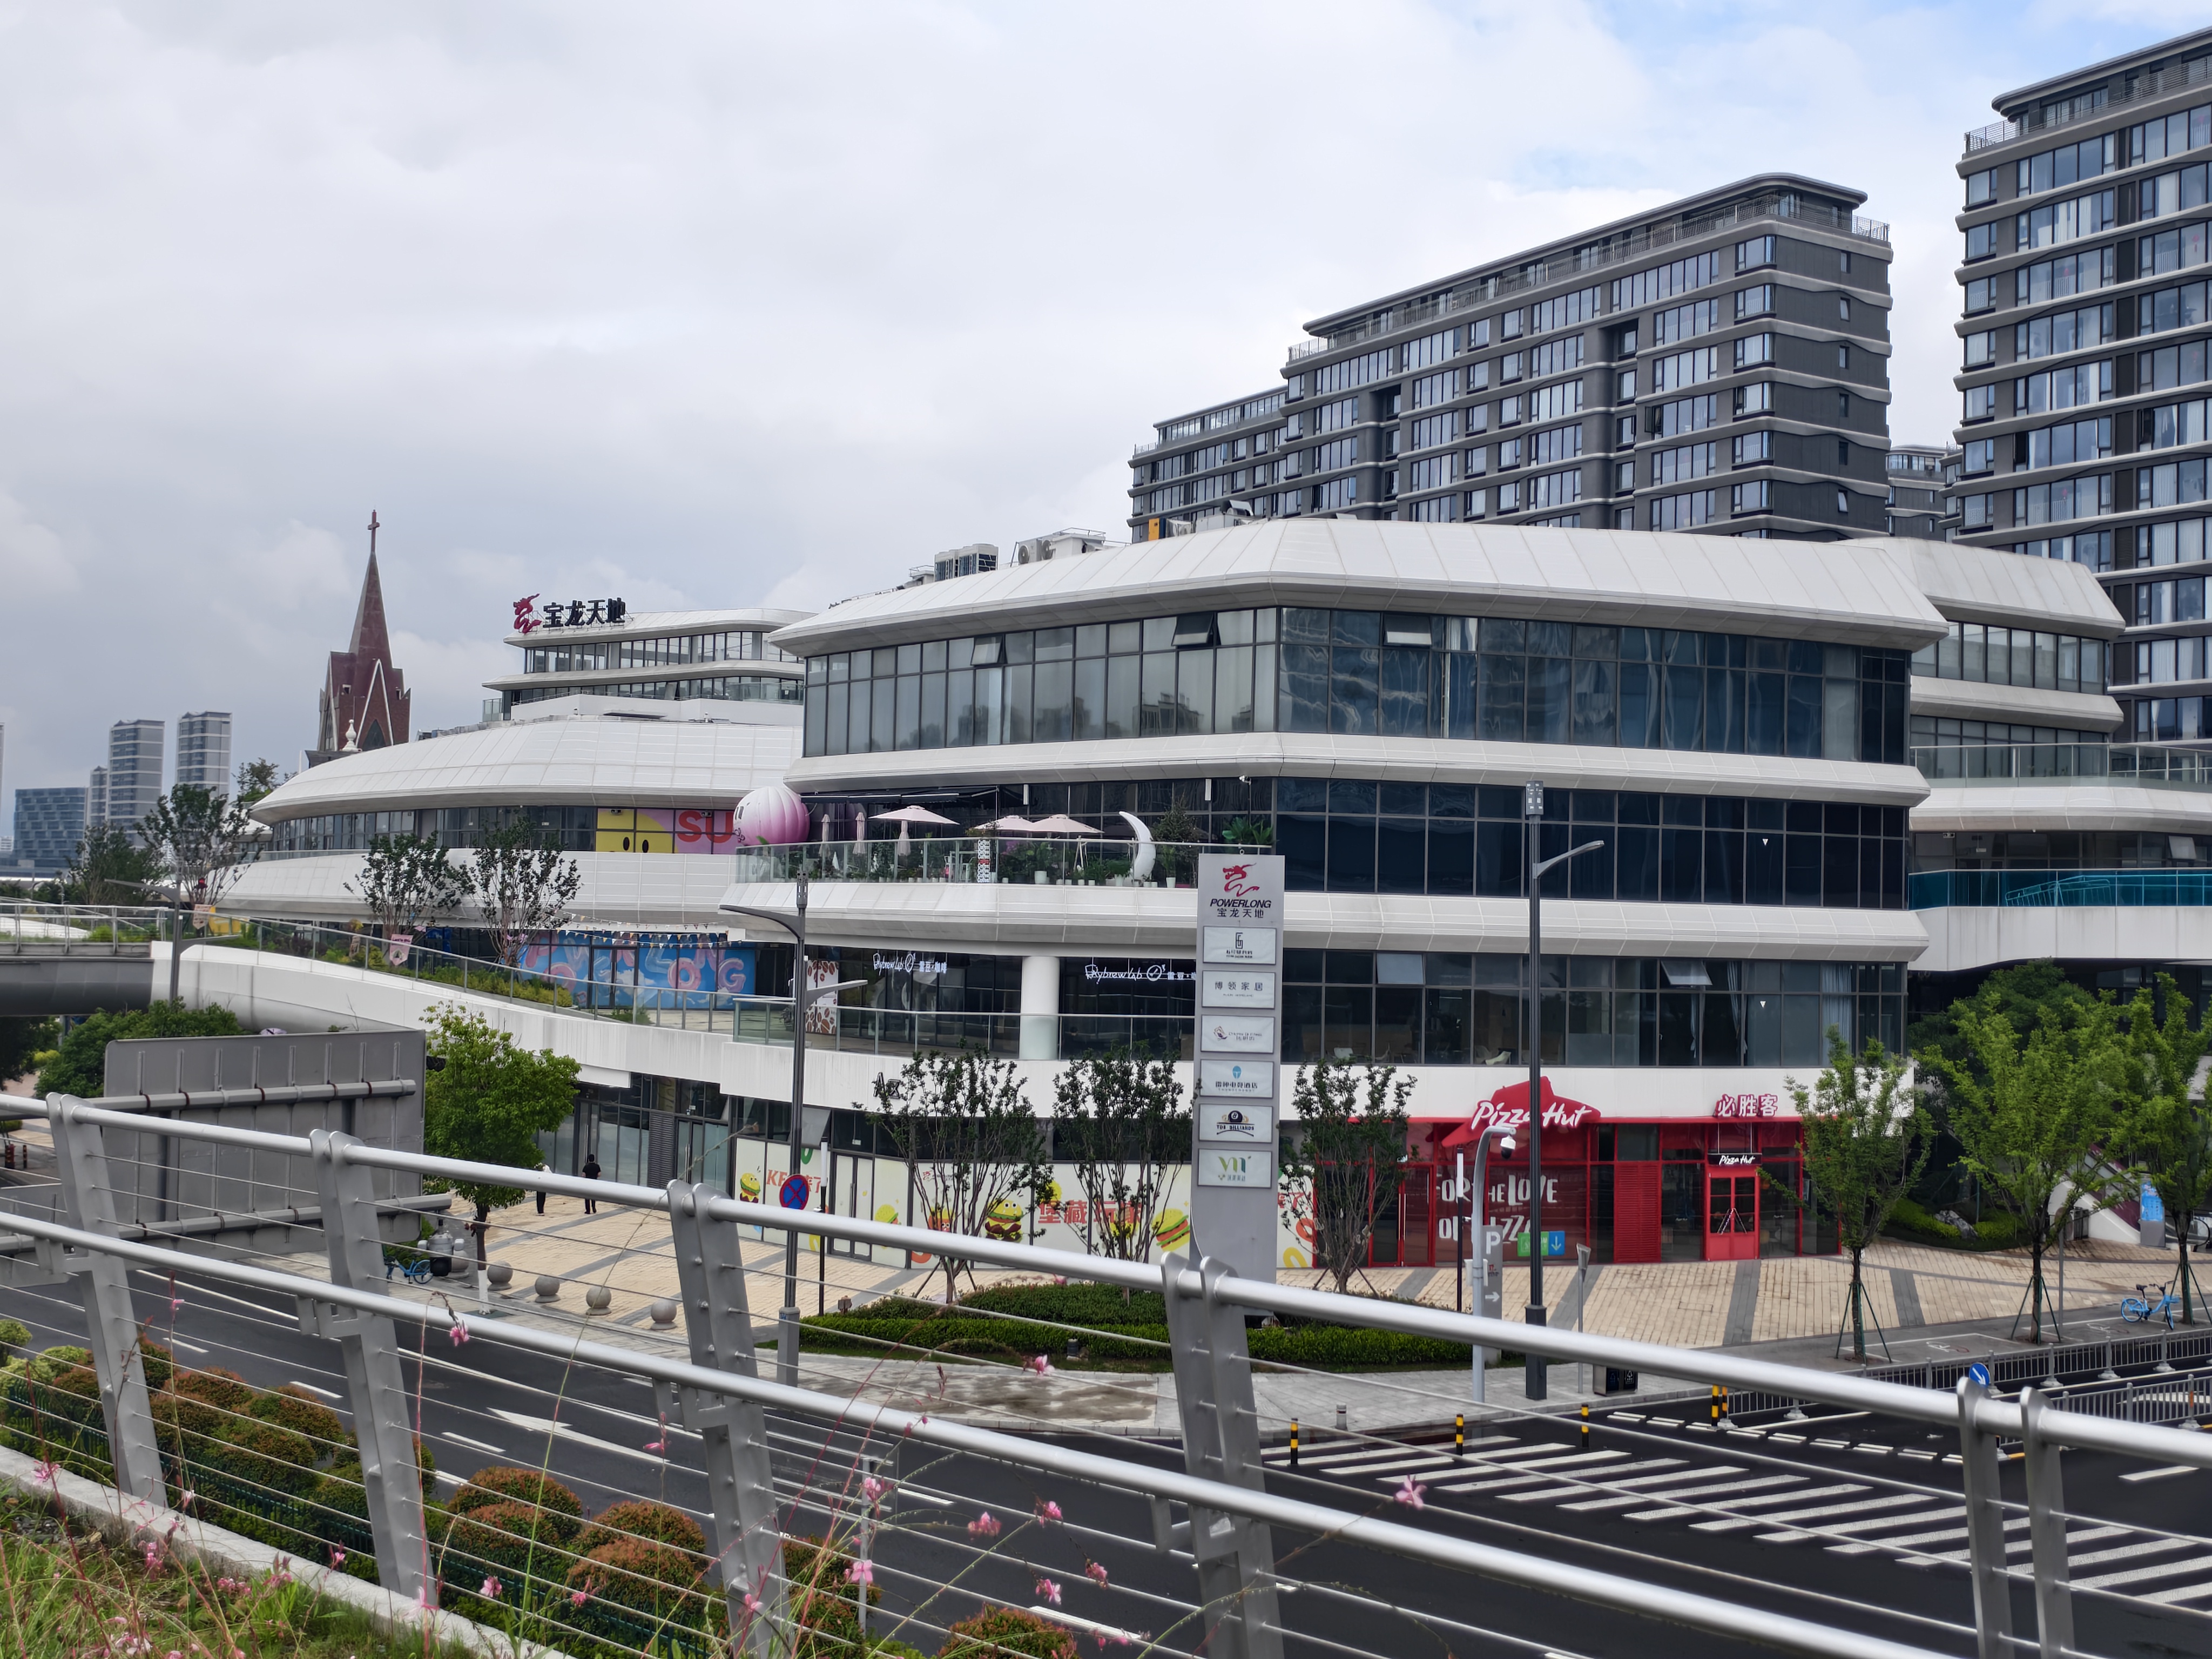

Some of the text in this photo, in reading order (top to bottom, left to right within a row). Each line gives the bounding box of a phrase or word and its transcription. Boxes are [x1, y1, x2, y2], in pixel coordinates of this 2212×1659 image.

[543, 597, 626, 628] 宝龙天地
[1210, 899, 1271, 908] POWERLONG
[1217, 908, 1264, 918] 宝龙天地
[1542, 1102, 1592, 1128] Hut
[1716, 1094, 1778, 1117] 必胜客
[1719, 1155, 1756, 1165] Pizza Hut
[767, 1170, 788, 1186] KF
[1486, 1231, 1501, 1255] P
